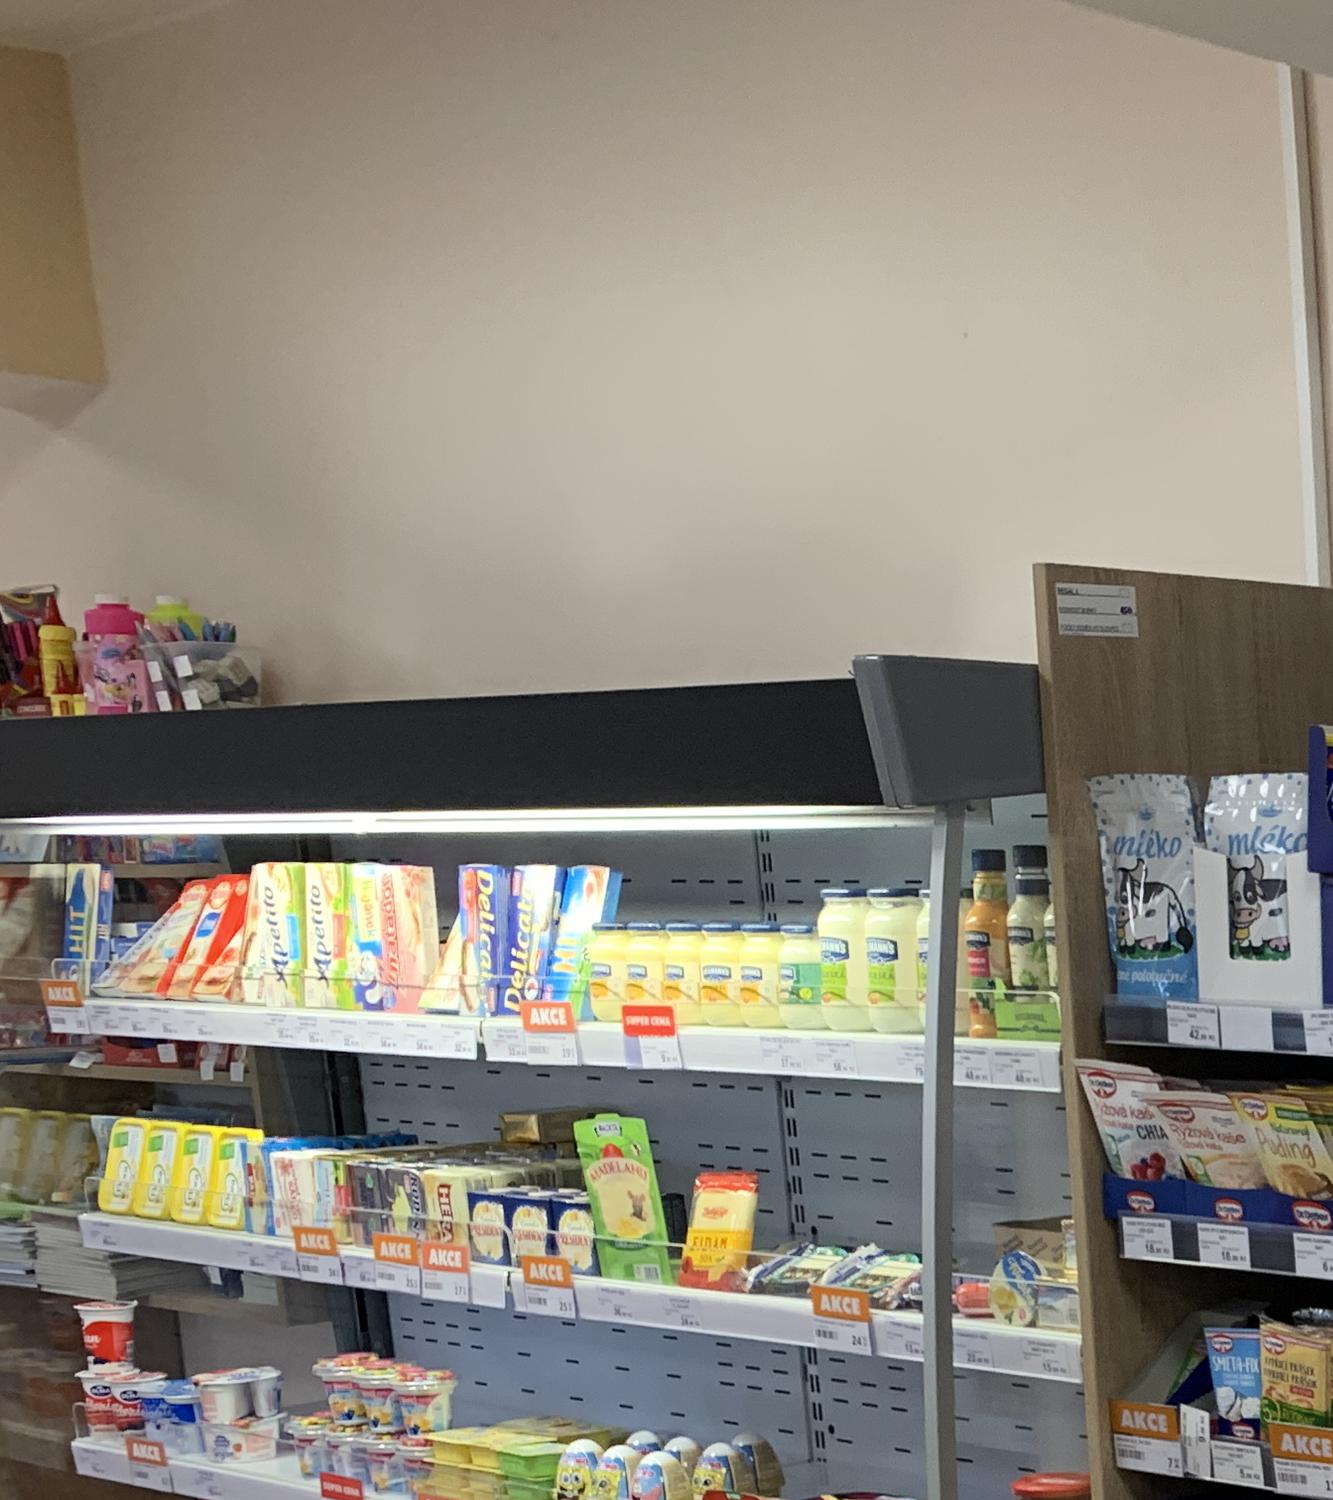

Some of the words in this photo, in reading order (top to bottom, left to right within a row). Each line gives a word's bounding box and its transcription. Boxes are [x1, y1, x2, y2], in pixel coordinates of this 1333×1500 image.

[1113, 830, 1182, 861] mléko
[529, 1008, 568, 1027] AKCE
[300, 1232, 332, 1251] AKCE
[819, 1293, 862, 1317] AKCE
[1120, 1409, 1168, 1434] AKCE
